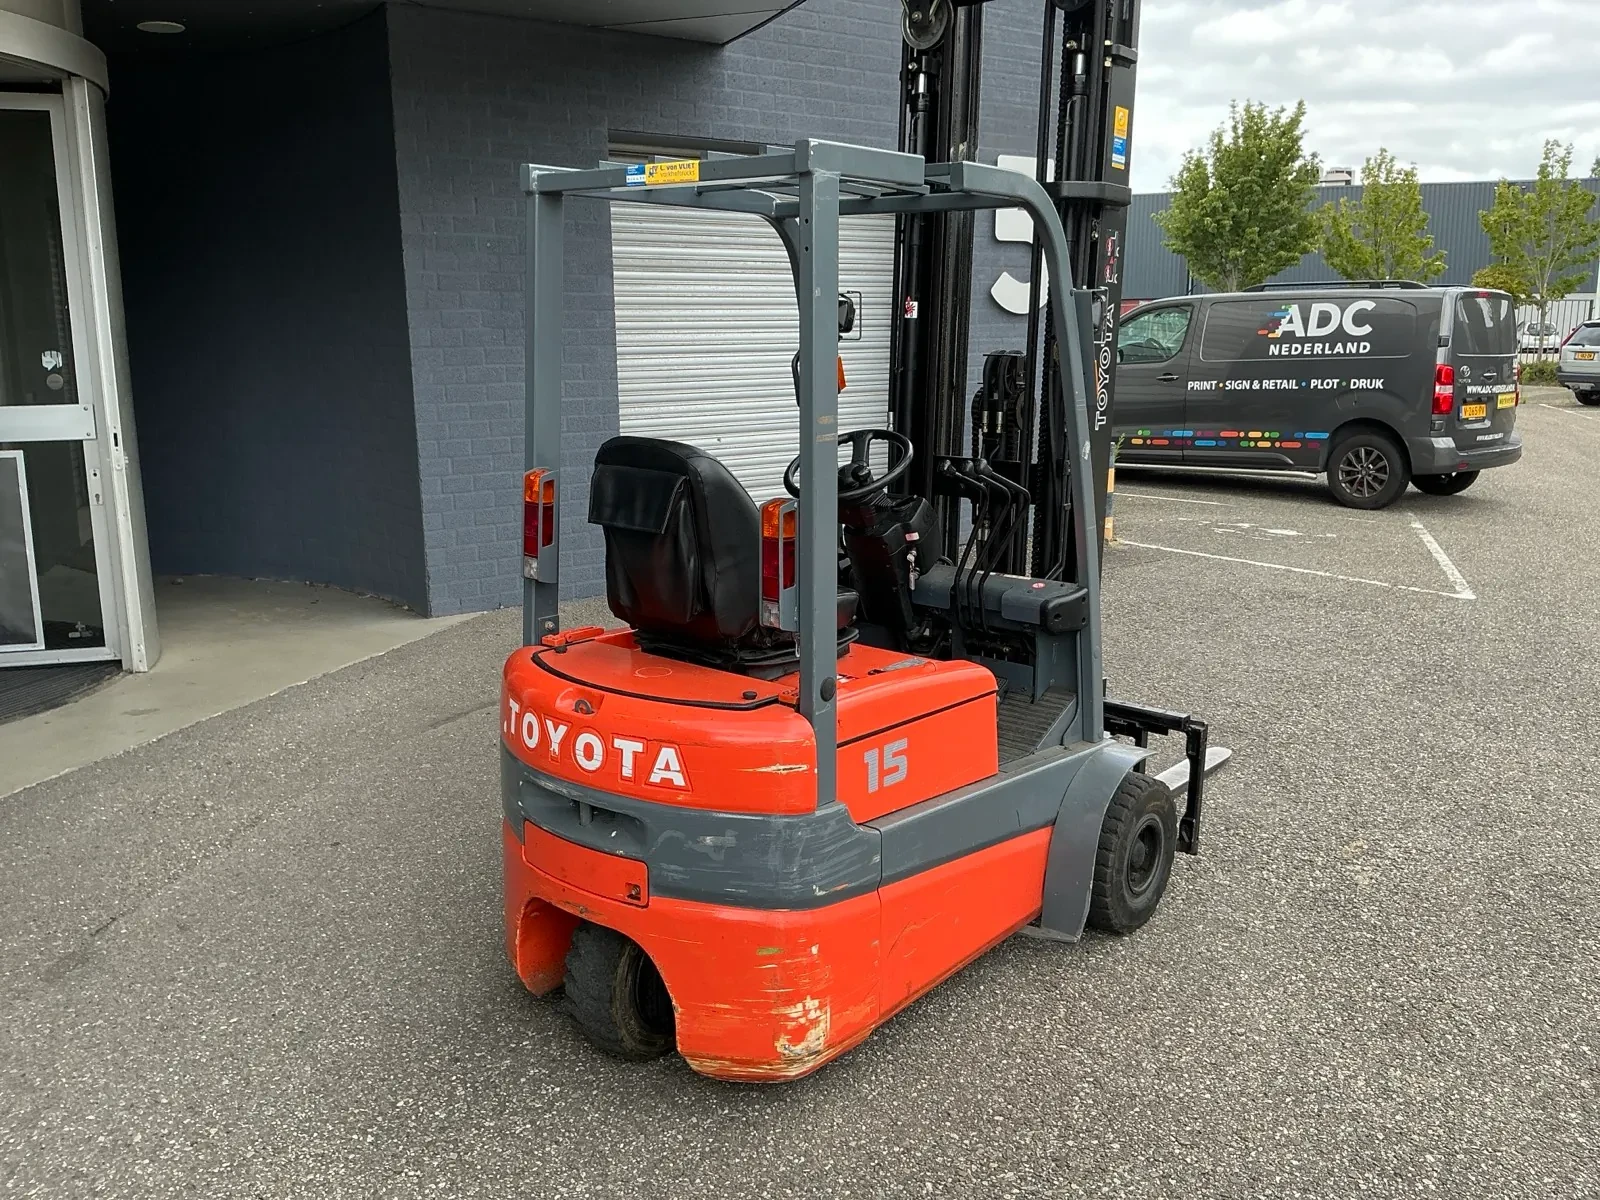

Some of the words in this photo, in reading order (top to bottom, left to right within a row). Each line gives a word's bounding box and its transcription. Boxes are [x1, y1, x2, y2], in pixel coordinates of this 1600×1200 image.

[679, 162, 695, 170] VLIET
[1271, 300, 1377, 338] ADC
[1095, 303, 1115, 431] TOYOTA
[1268, 342, 1371, 356] NEDERLAND
[1187, 380, 1218, 391] PRINT
[1225, 379, 1251, 390] SIGN
[1252, 380, 1261, 390] &
[1262, 379, 1298, 390] RETAIL
[1310, 378, 1339, 390] PLOT
[1350, 378, 1385, 390] DRUK
[509, 697, 686, 787] TOYOTA
[864, 738, 908, 794] 15
